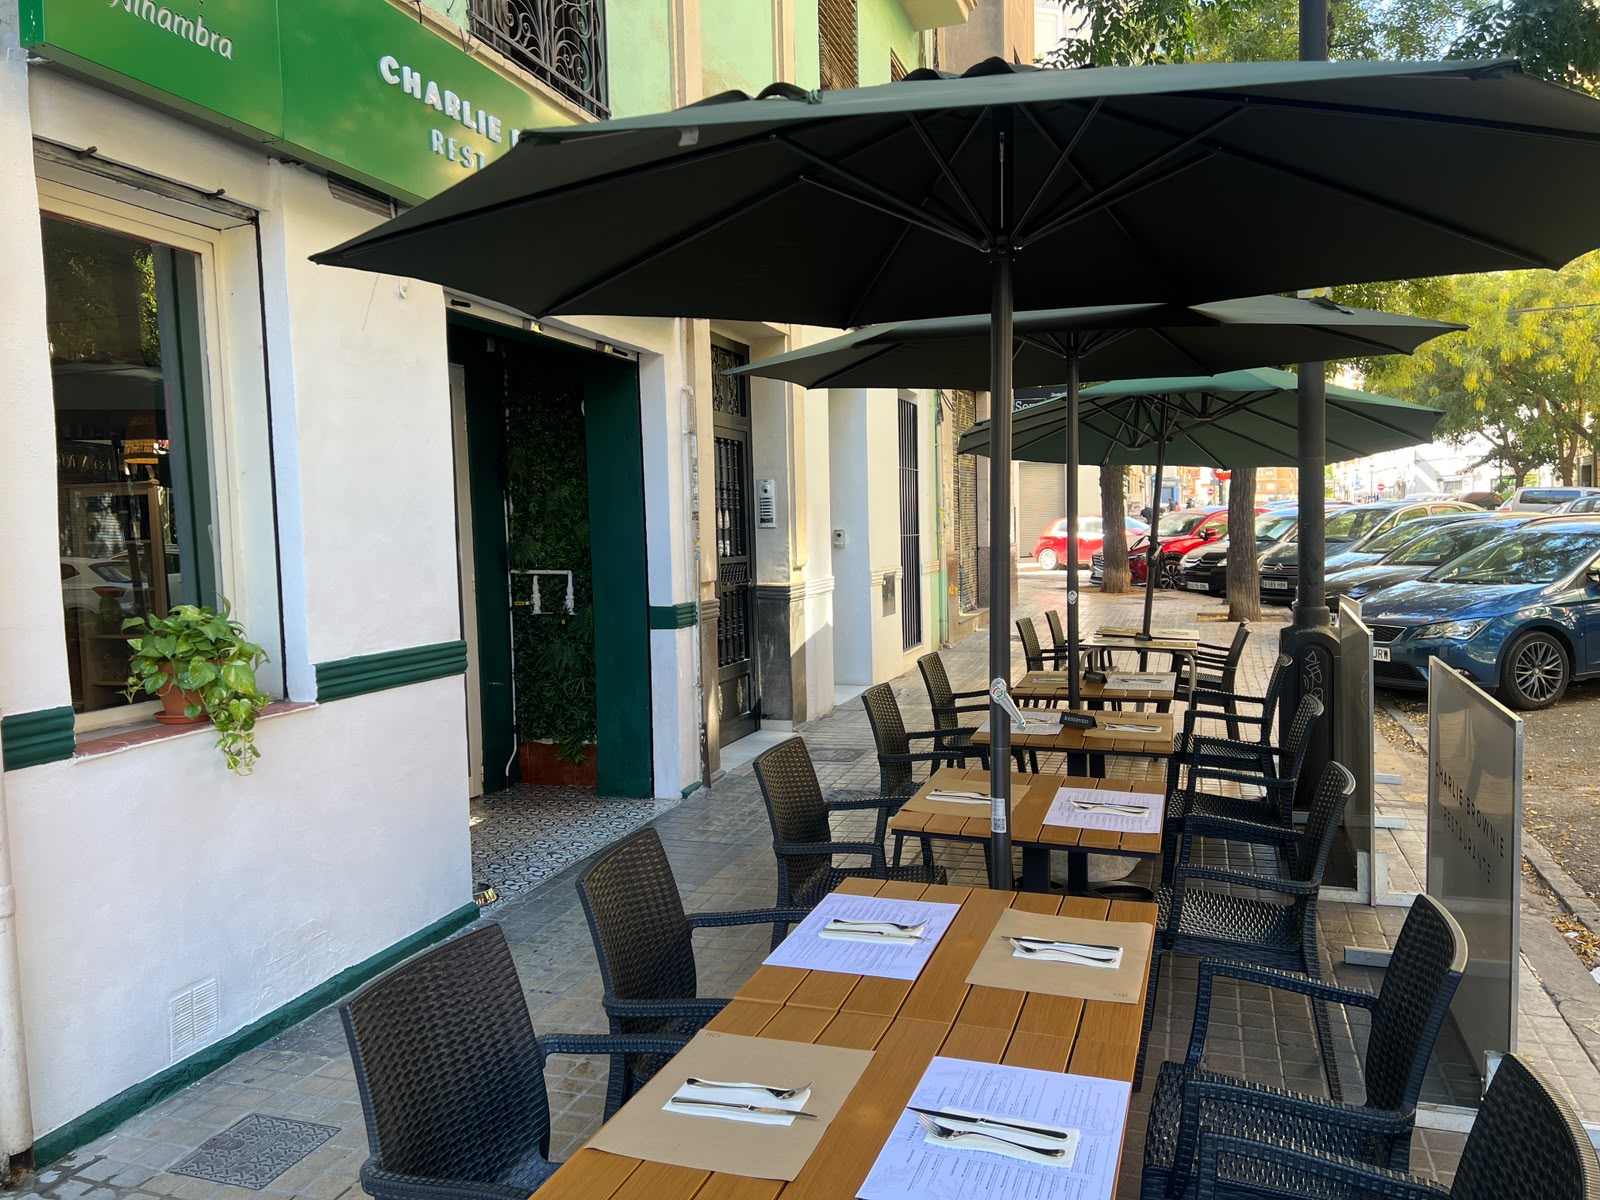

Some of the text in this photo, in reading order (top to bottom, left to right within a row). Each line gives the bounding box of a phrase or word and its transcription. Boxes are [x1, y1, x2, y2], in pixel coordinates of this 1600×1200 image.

[379, 55, 502, 143] CHARLIE
[1063, 715, 1089, 724] RESERVED
[1435, 761, 1504, 859] CHARLIE BROWNIE
[1443, 806, 1491, 884] RESTAURANTE
